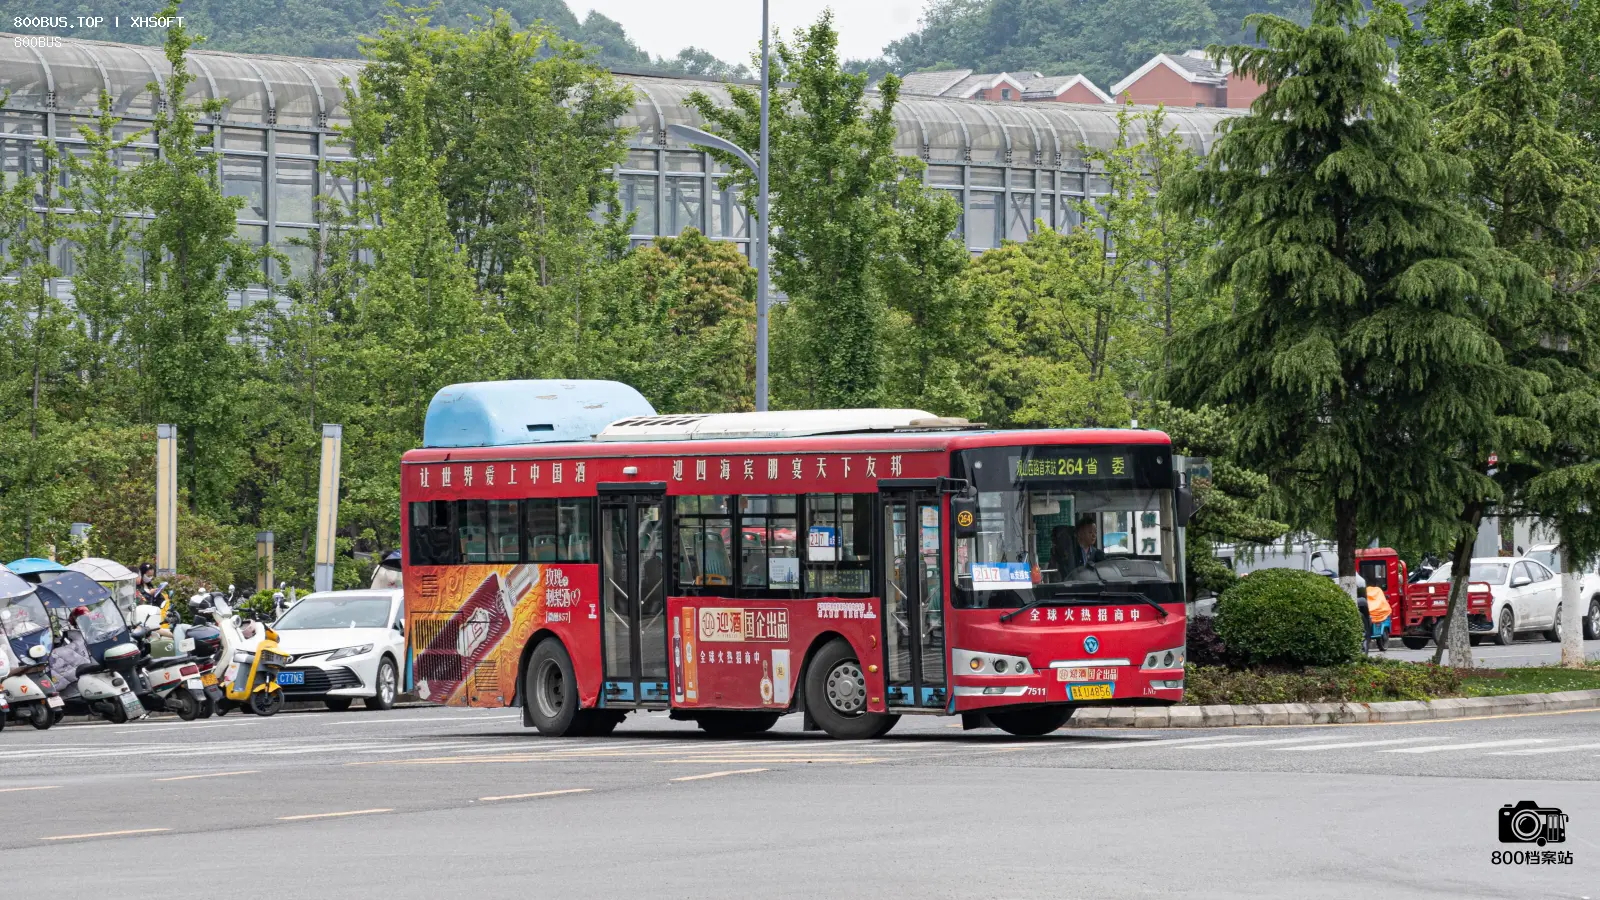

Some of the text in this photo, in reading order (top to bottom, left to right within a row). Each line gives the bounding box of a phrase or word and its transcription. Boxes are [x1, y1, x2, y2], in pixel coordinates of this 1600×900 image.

[672, 455, 902, 481] 迎四海宾朋宴天下友邦
[1058, 457, 1083, 475] 264
[419, 461, 586, 488] 让世界爱上中国酒
[810, 533, 824, 546] 217
[974, 568, 999, 580] 217
[1030, 608, 1140, 622] 全球火热招商中
[716, 611, 742, 634] 迎酒
[744, 611, 788, 639] 国企出品
[699, 650, 760, 665] 全球火热招商中
[279, 673, 303, 683] C77N3
[1088, 668, 1117, 681] 国企出品
[1027, 687, 1046, 696] 7511
[1143, 687, 1156, 696] LNG
